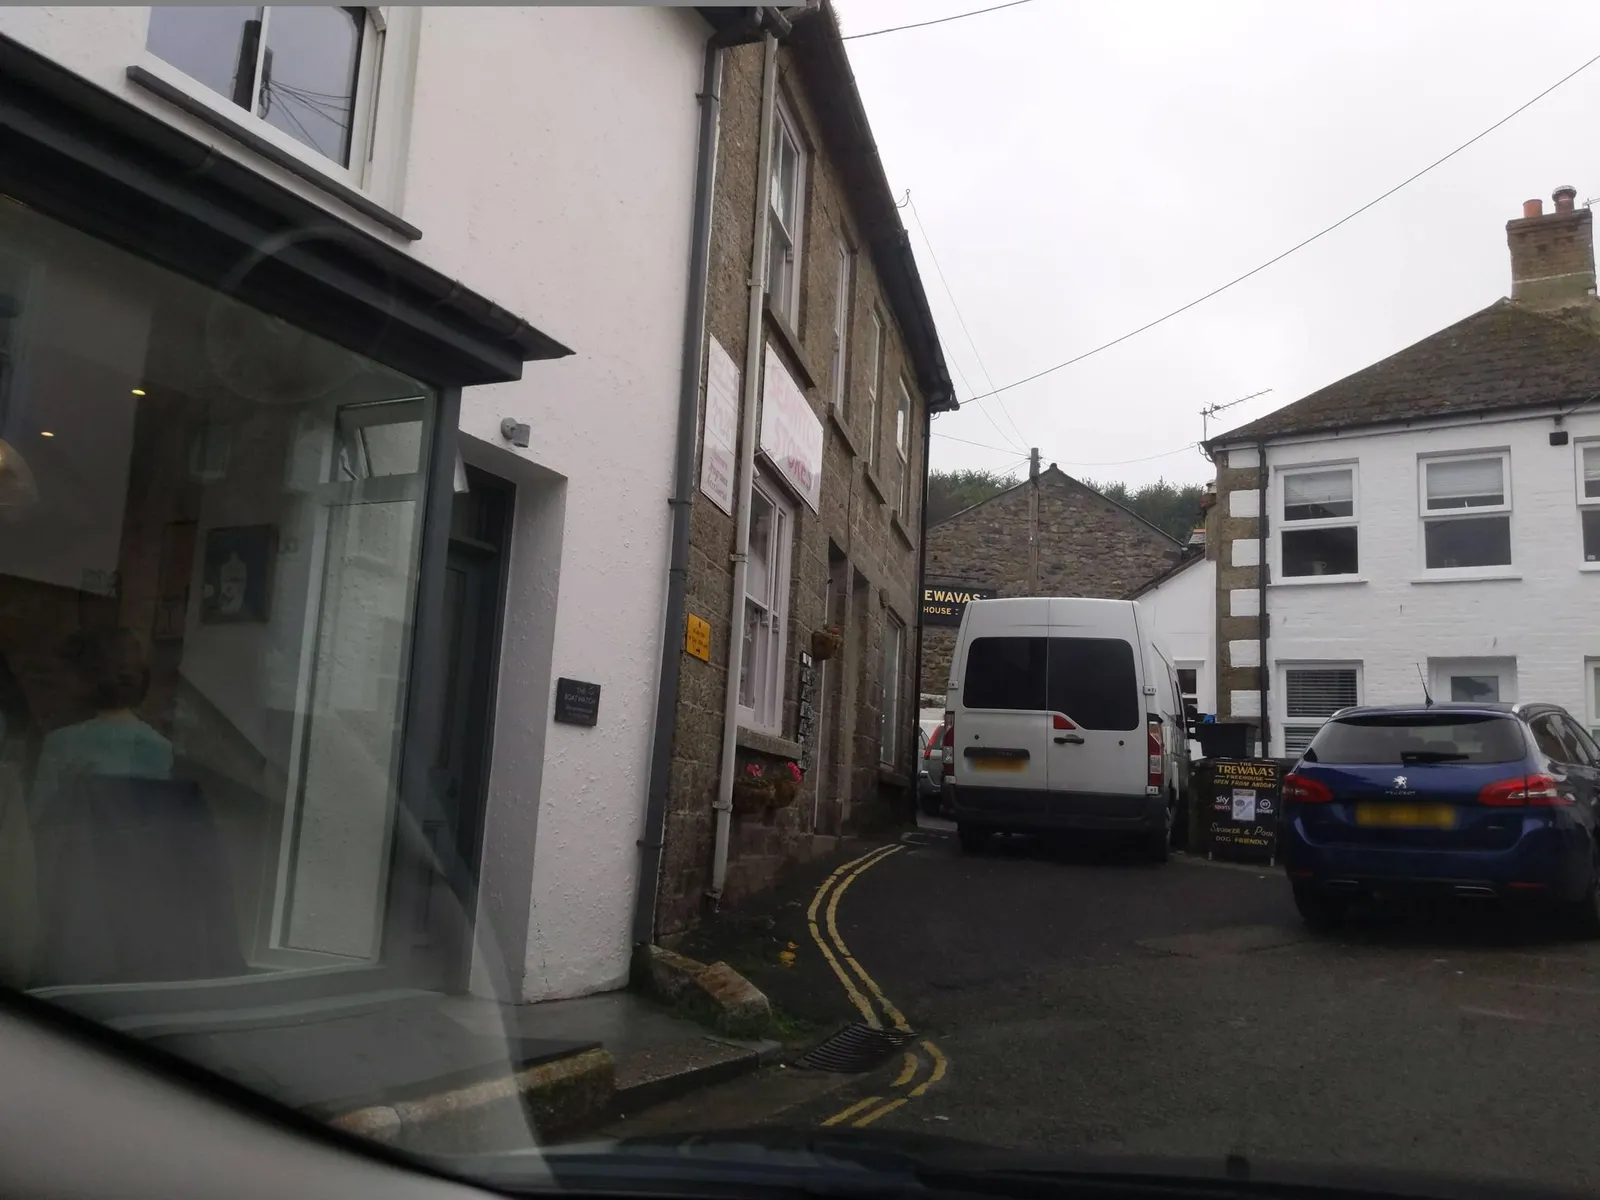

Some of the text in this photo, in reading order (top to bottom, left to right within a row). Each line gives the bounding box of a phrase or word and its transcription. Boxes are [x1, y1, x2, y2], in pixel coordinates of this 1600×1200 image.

[923, 606, 952, 615] HOUSE
[1216, 764, 1275, 777] TREWAVAS
[1235, 837, 1268, 845] FRIENDLY
